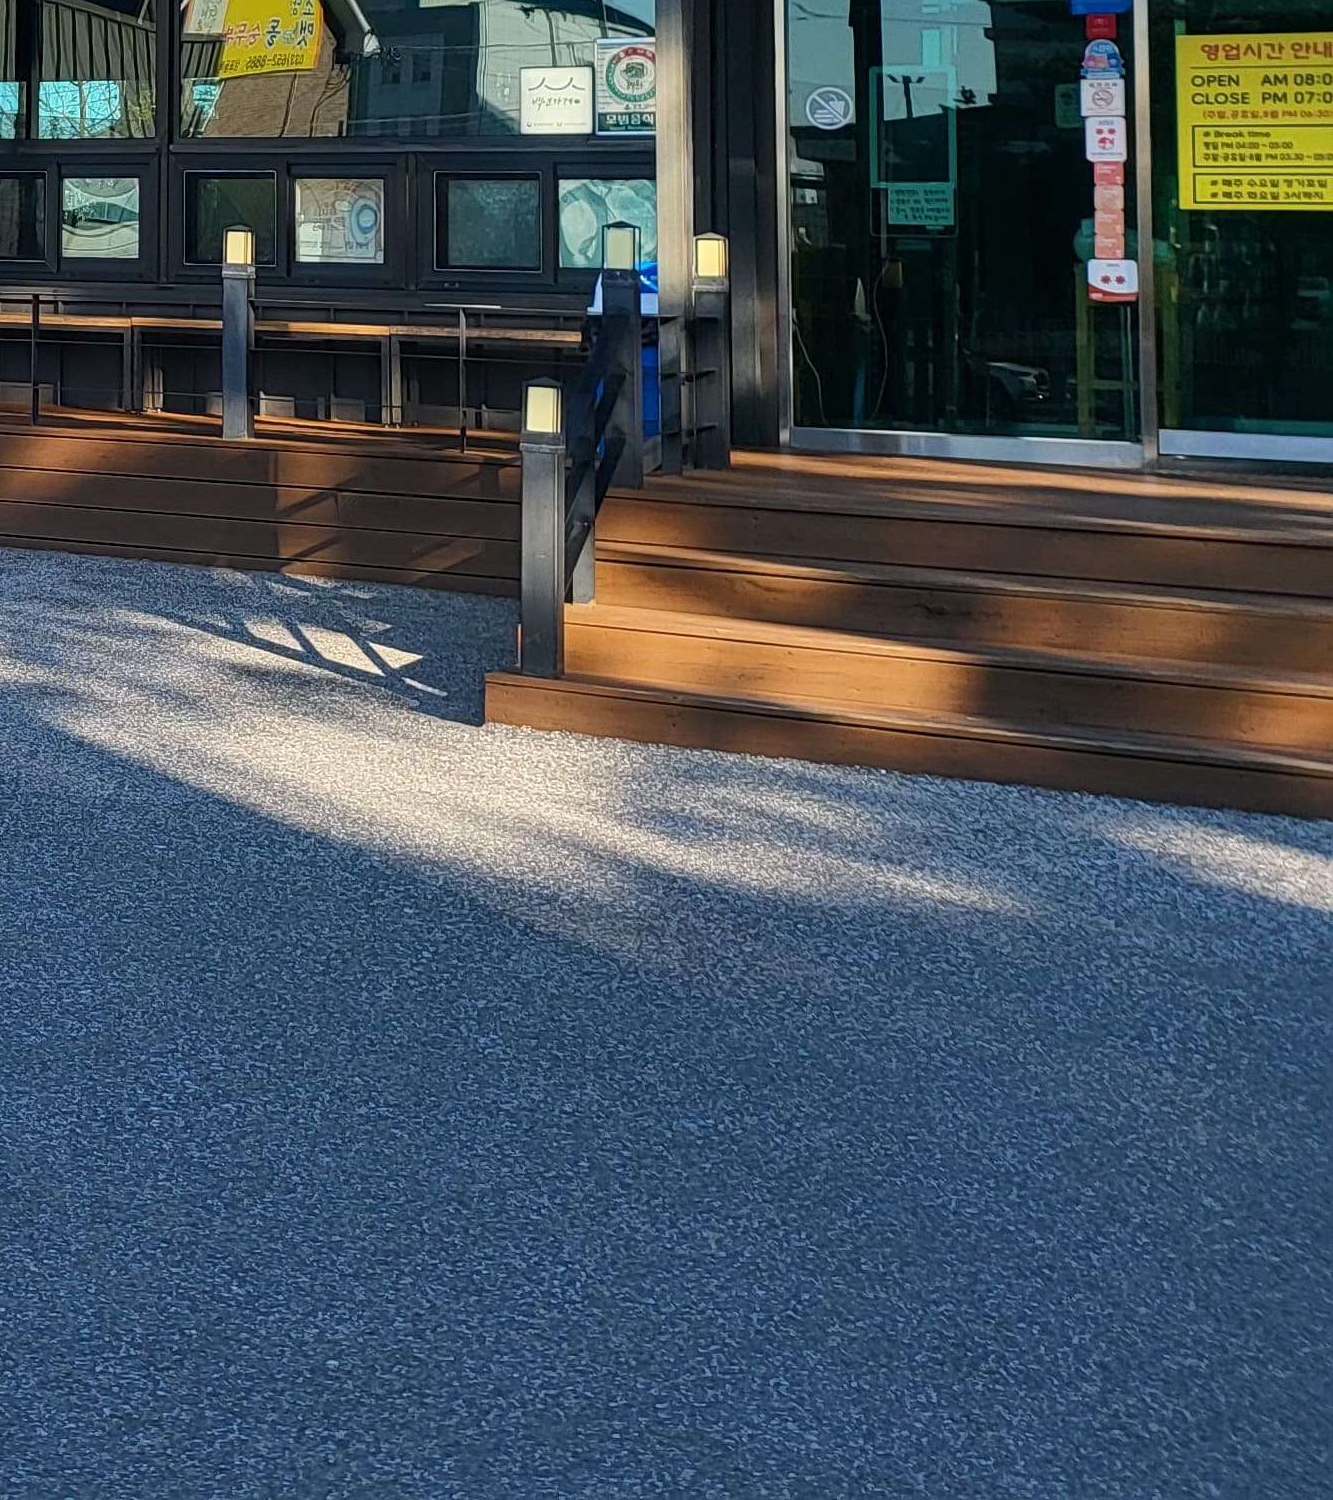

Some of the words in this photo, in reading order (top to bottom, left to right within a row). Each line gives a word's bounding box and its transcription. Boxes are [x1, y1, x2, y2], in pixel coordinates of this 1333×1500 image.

[1200, 41, 1285, 61] 영업시간
[1191, 74, 1240, 88] OPEN
[1261, 73, 1289, 87] AM
[1191, 92, 1250, 106] CLOSE
[1261, 91, 1288, 105] PM
[605, 112, 654, 126] 모범음식
[1214, 130, 1245, 139] Break
[1220, 142, 1234, 150] PM
[1247, 178, 1280, 189] 수요일
